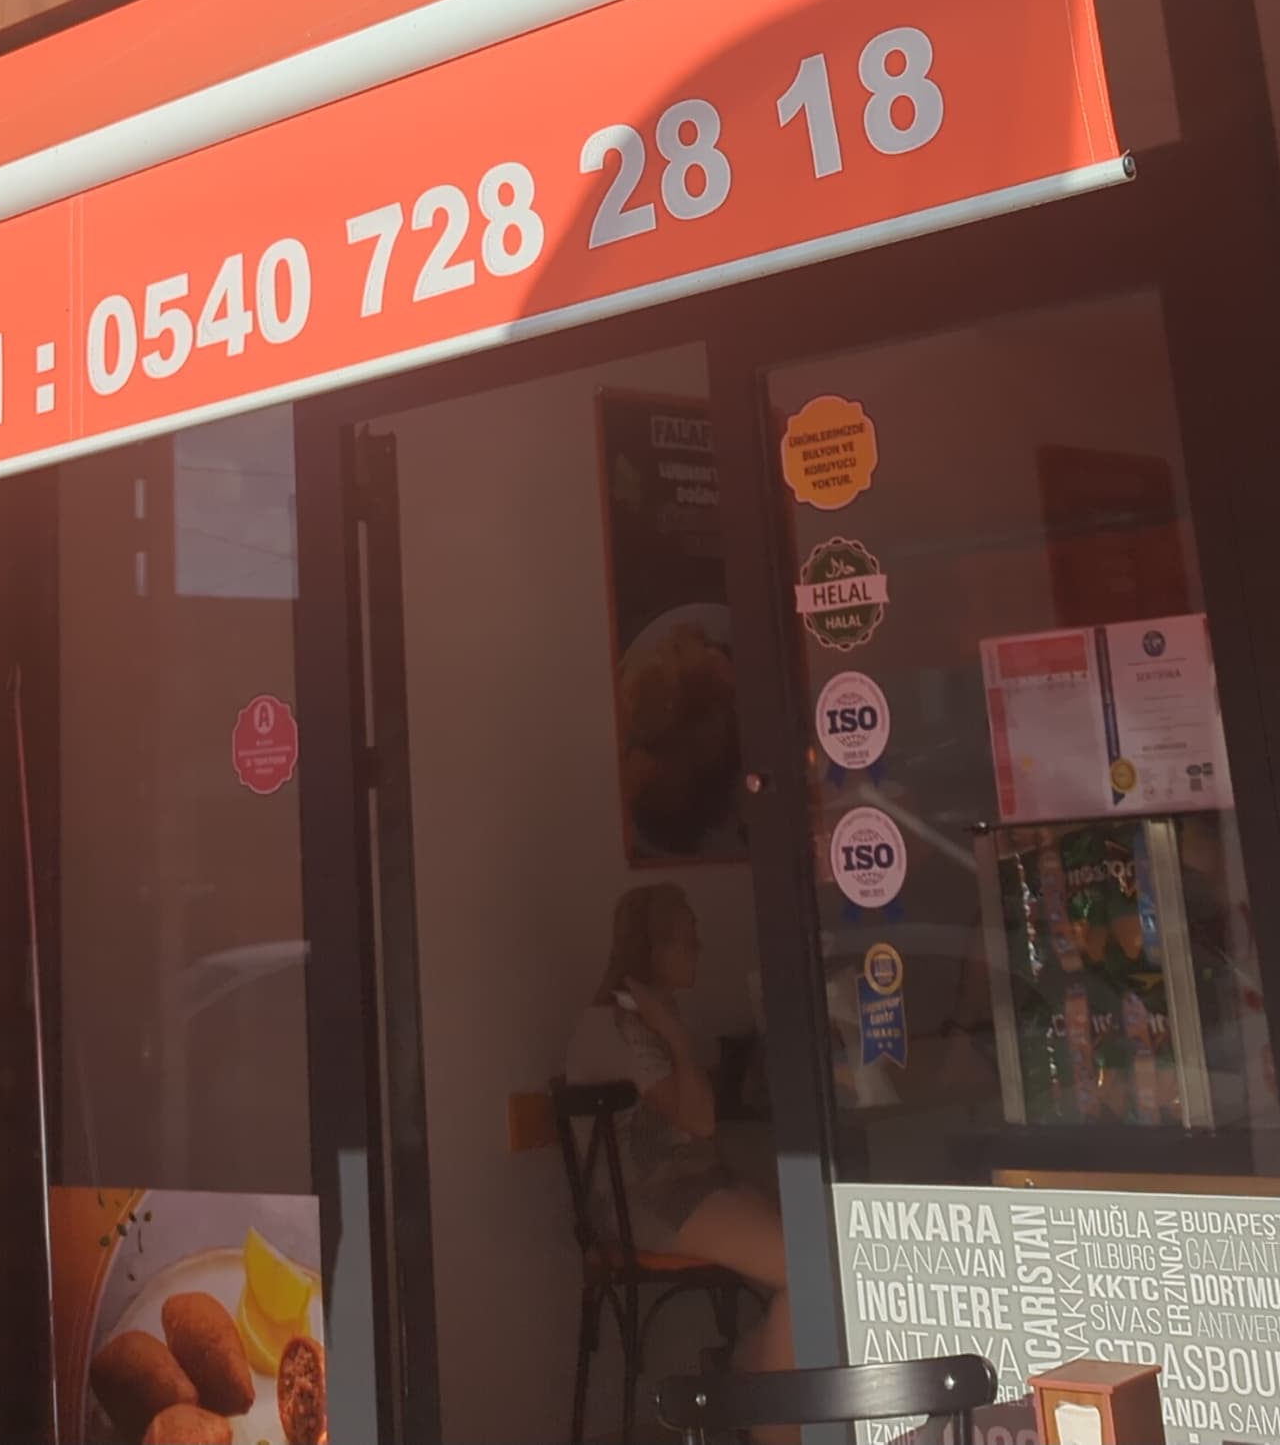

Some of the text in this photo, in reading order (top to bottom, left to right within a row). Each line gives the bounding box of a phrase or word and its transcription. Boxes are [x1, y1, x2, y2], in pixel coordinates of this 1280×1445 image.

[86, 237, 312, 397] 0540
[345, 161, 544, 319] 728
[579, 98, 732, 251] 28
[776, 26, 944, 180] 18
[811, 581, 873, 608] HELAL
[824, 613, 863, 631] HALAL
[825, 705, 879, 736] ISO
[840, 842, 895, 873] ISO
[848, 1199, 1002, 1245] ANKARA
[1077, 1204, 1152, 1240] MUĞLA
[851, 1242, 1007, 1279] ADANA VAN
[1081, 1241, 1156, 1272] TILBURG
[1154, 1209, 1193, 1337] ERZİNCAN
[855, 1271, 1013, 1332] İNGİLTERE
[1086, 1273, 1160, 1302] KKTC
[1089, 1300, 1163, 1336] SİVAS
